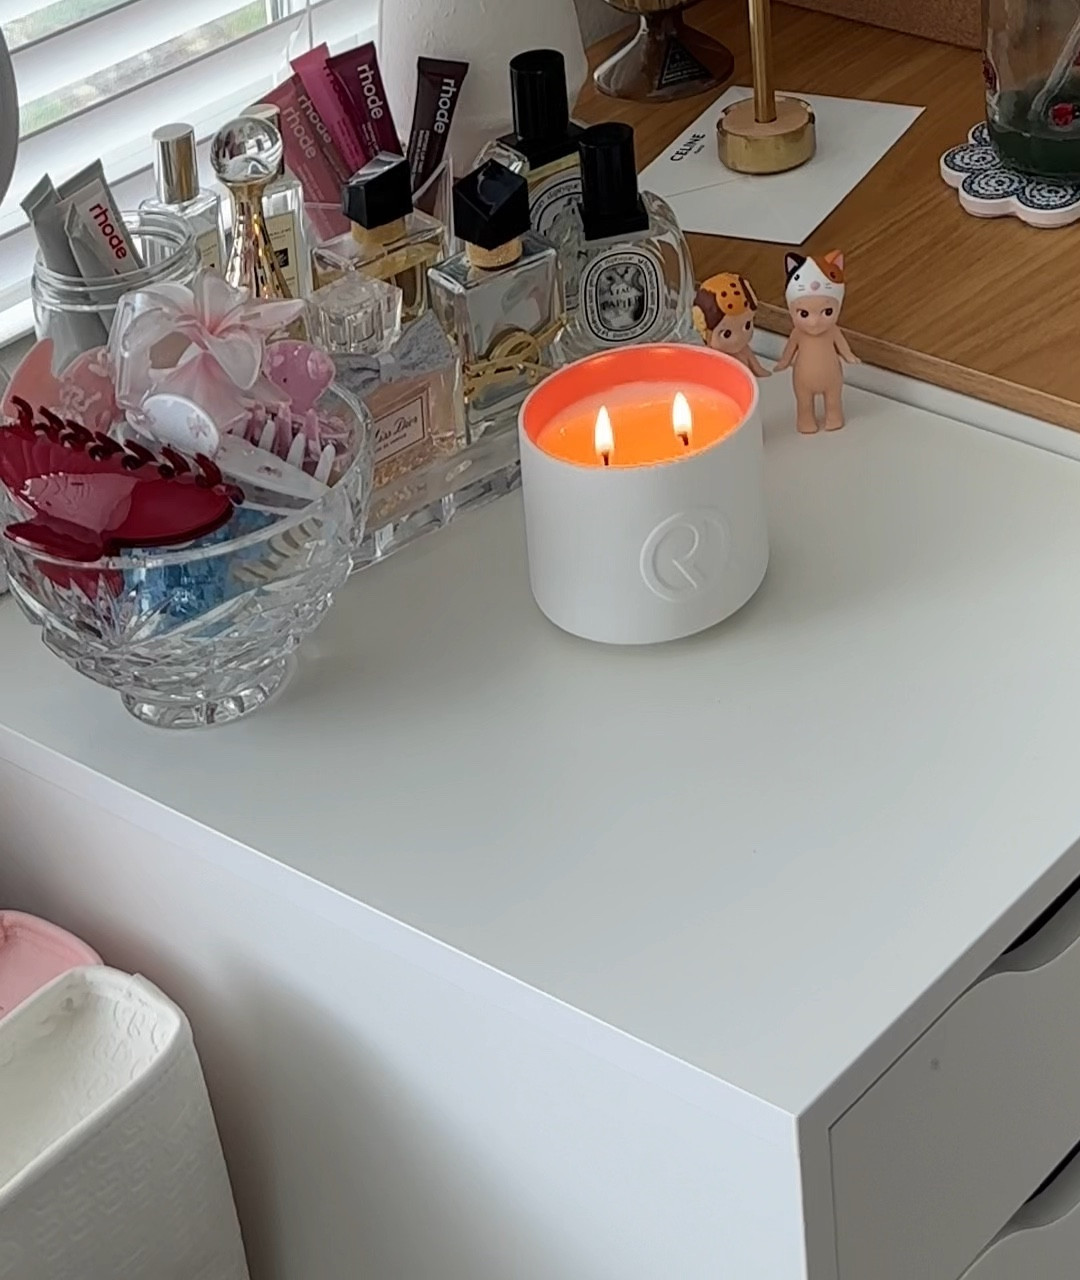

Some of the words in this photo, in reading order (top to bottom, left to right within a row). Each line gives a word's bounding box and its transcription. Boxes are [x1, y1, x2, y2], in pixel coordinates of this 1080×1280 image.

[357, 63, 384, 120] rhode
[433, 77, 457, 134] rhode
[283, 106, 317, 160] rhode
[298, 95, 332, 144] rhode
[670, 133, 706, 162] CELINE
[89, 203, 128, 260] rhode
